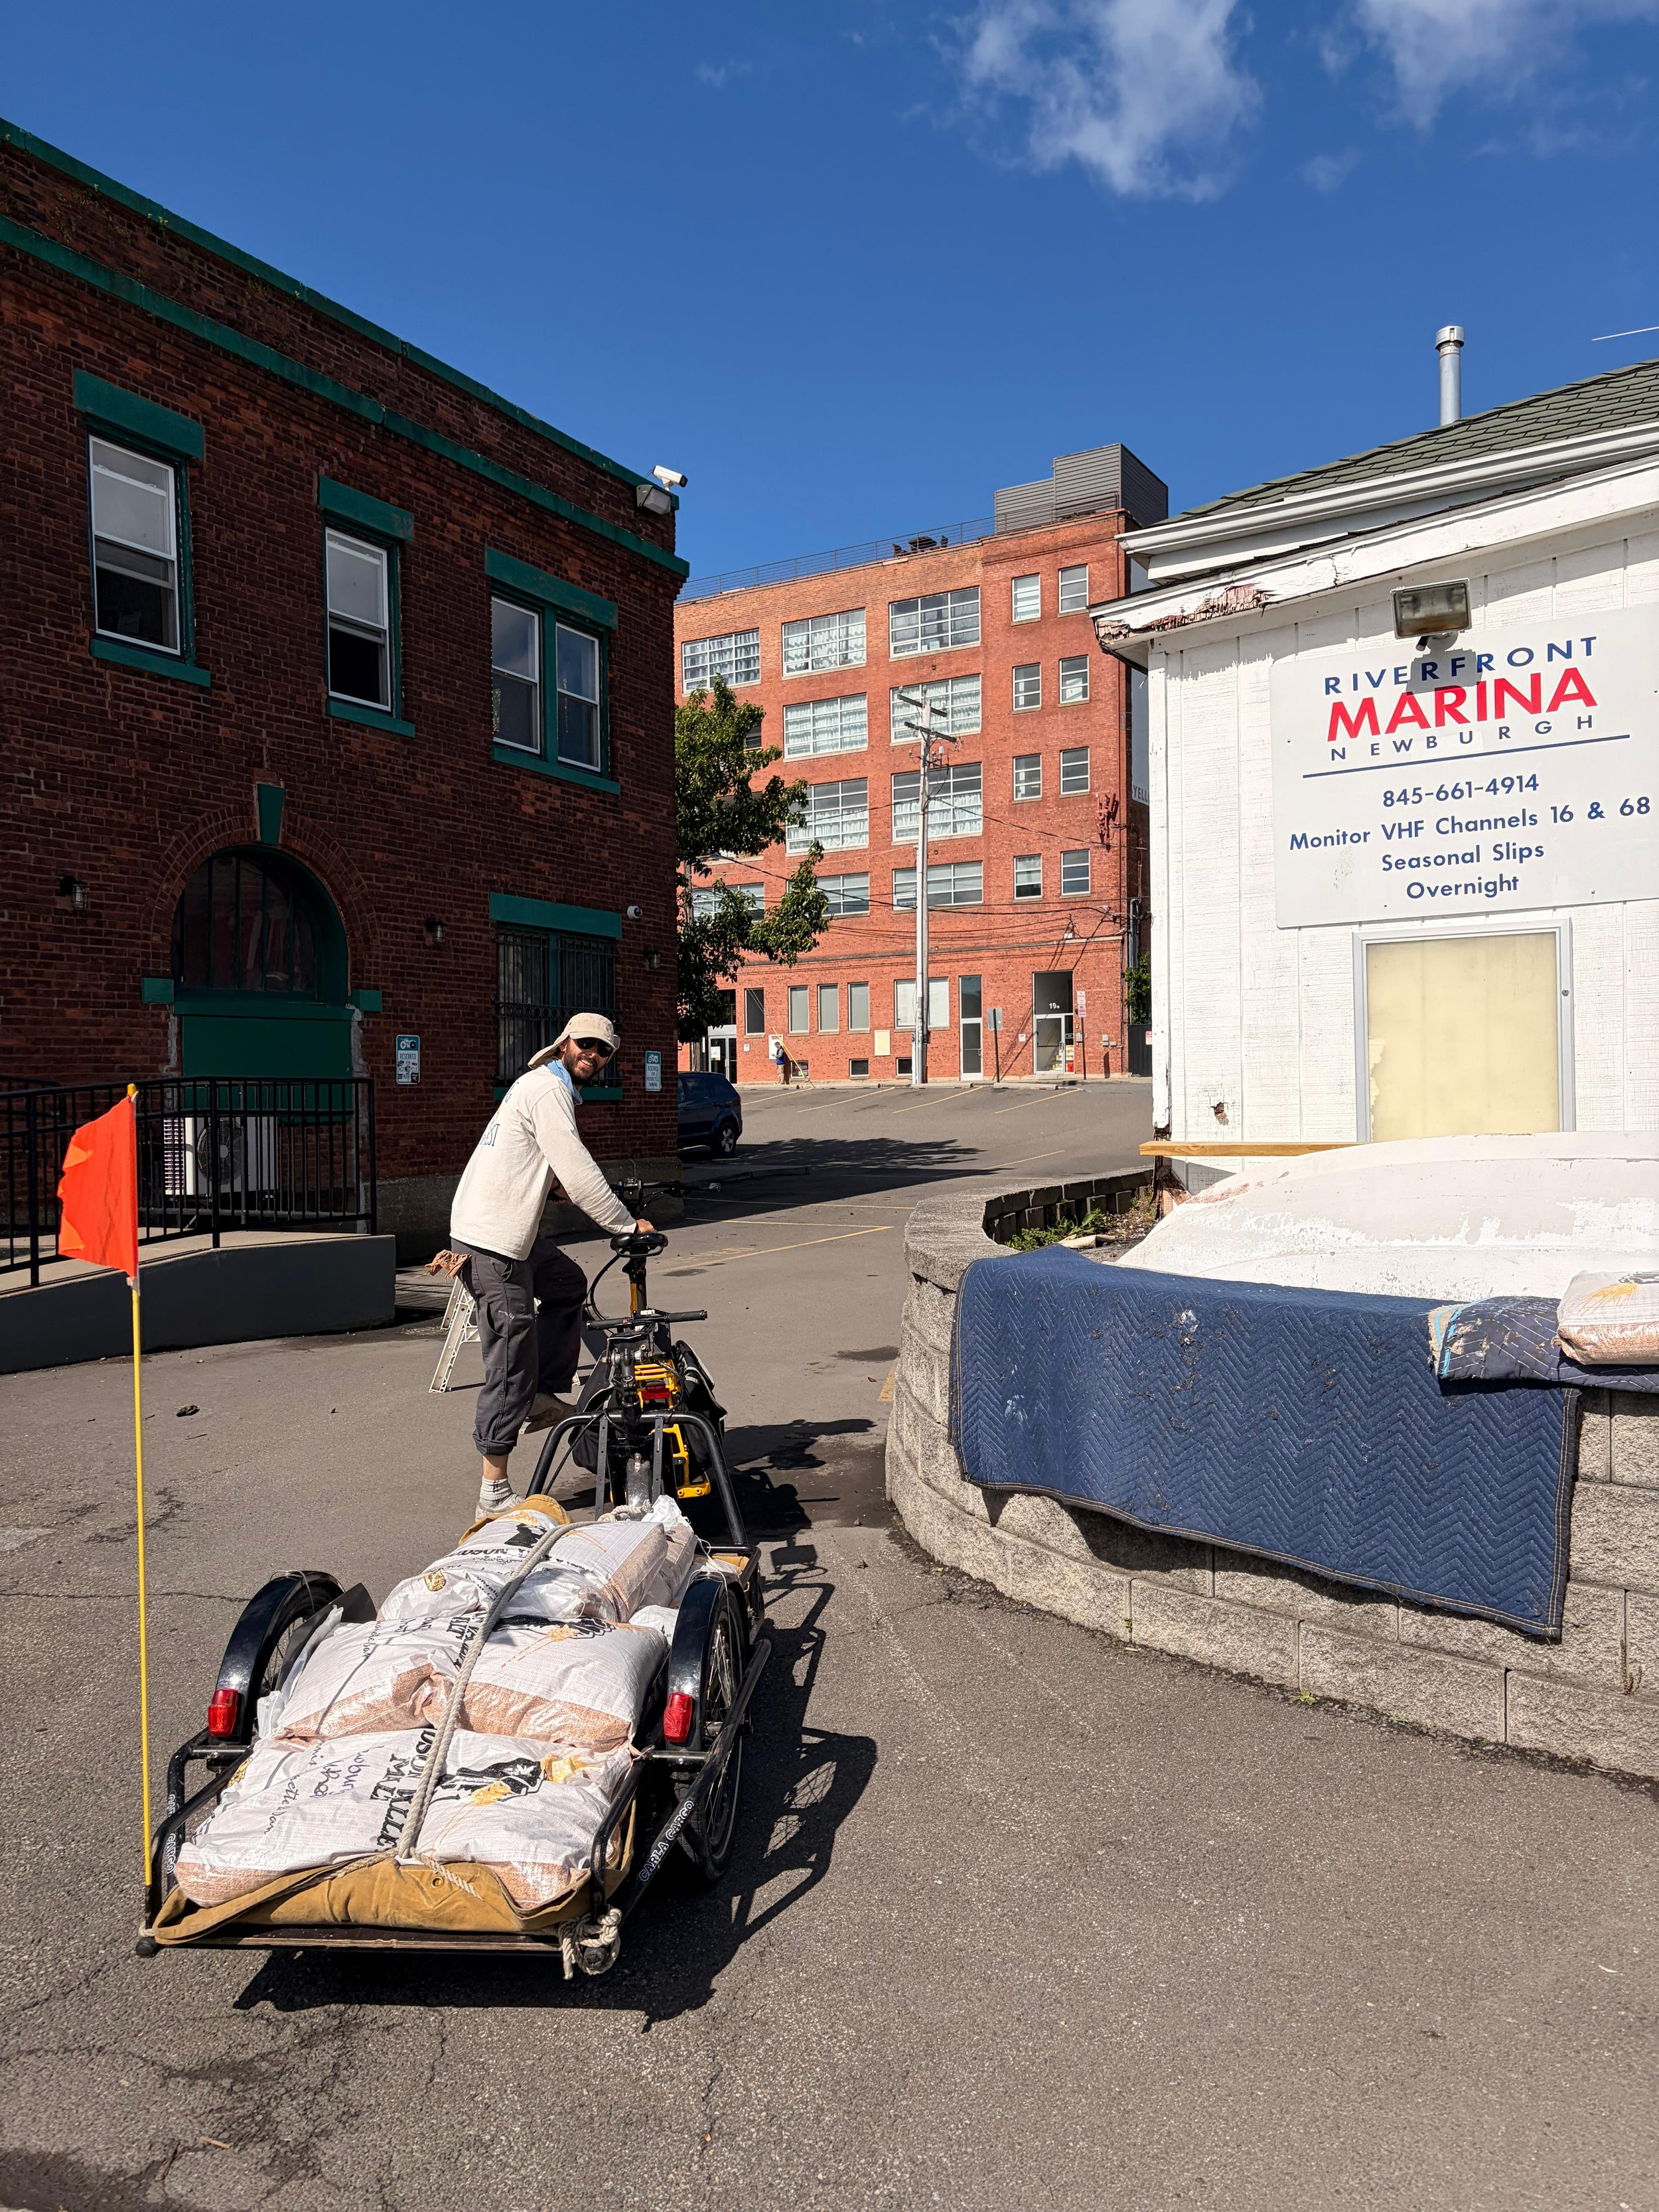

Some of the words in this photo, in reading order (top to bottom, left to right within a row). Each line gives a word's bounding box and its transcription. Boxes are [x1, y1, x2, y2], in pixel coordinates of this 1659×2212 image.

[1325, 636, 1597, 696] RIVERFRONT
[1327, 667, 1598, 742] MARINA
[1331, 715, 1593, 761] NEWBURGH
[1382, 774, 1539, 808] 845-661-4914
[1289, 829, 1370, 850] Monitor
[1381, 819, 1425, 841] VHF
[1435, 808, 1538, 835] Channels
[1550, 804, 1574, 824] 16
[1587, 801, 1605, 820] &
[1619, 796, 1651, 816] 68
[1382, 844, 1480, 872] Seasonal
[1492, 842, 1545, 863] Slips
[1406, 873, 1519, 899] Overnight
[638, 1841, 670, 1881] CARLA
[665, 1800, 695, 1841] CARGO
